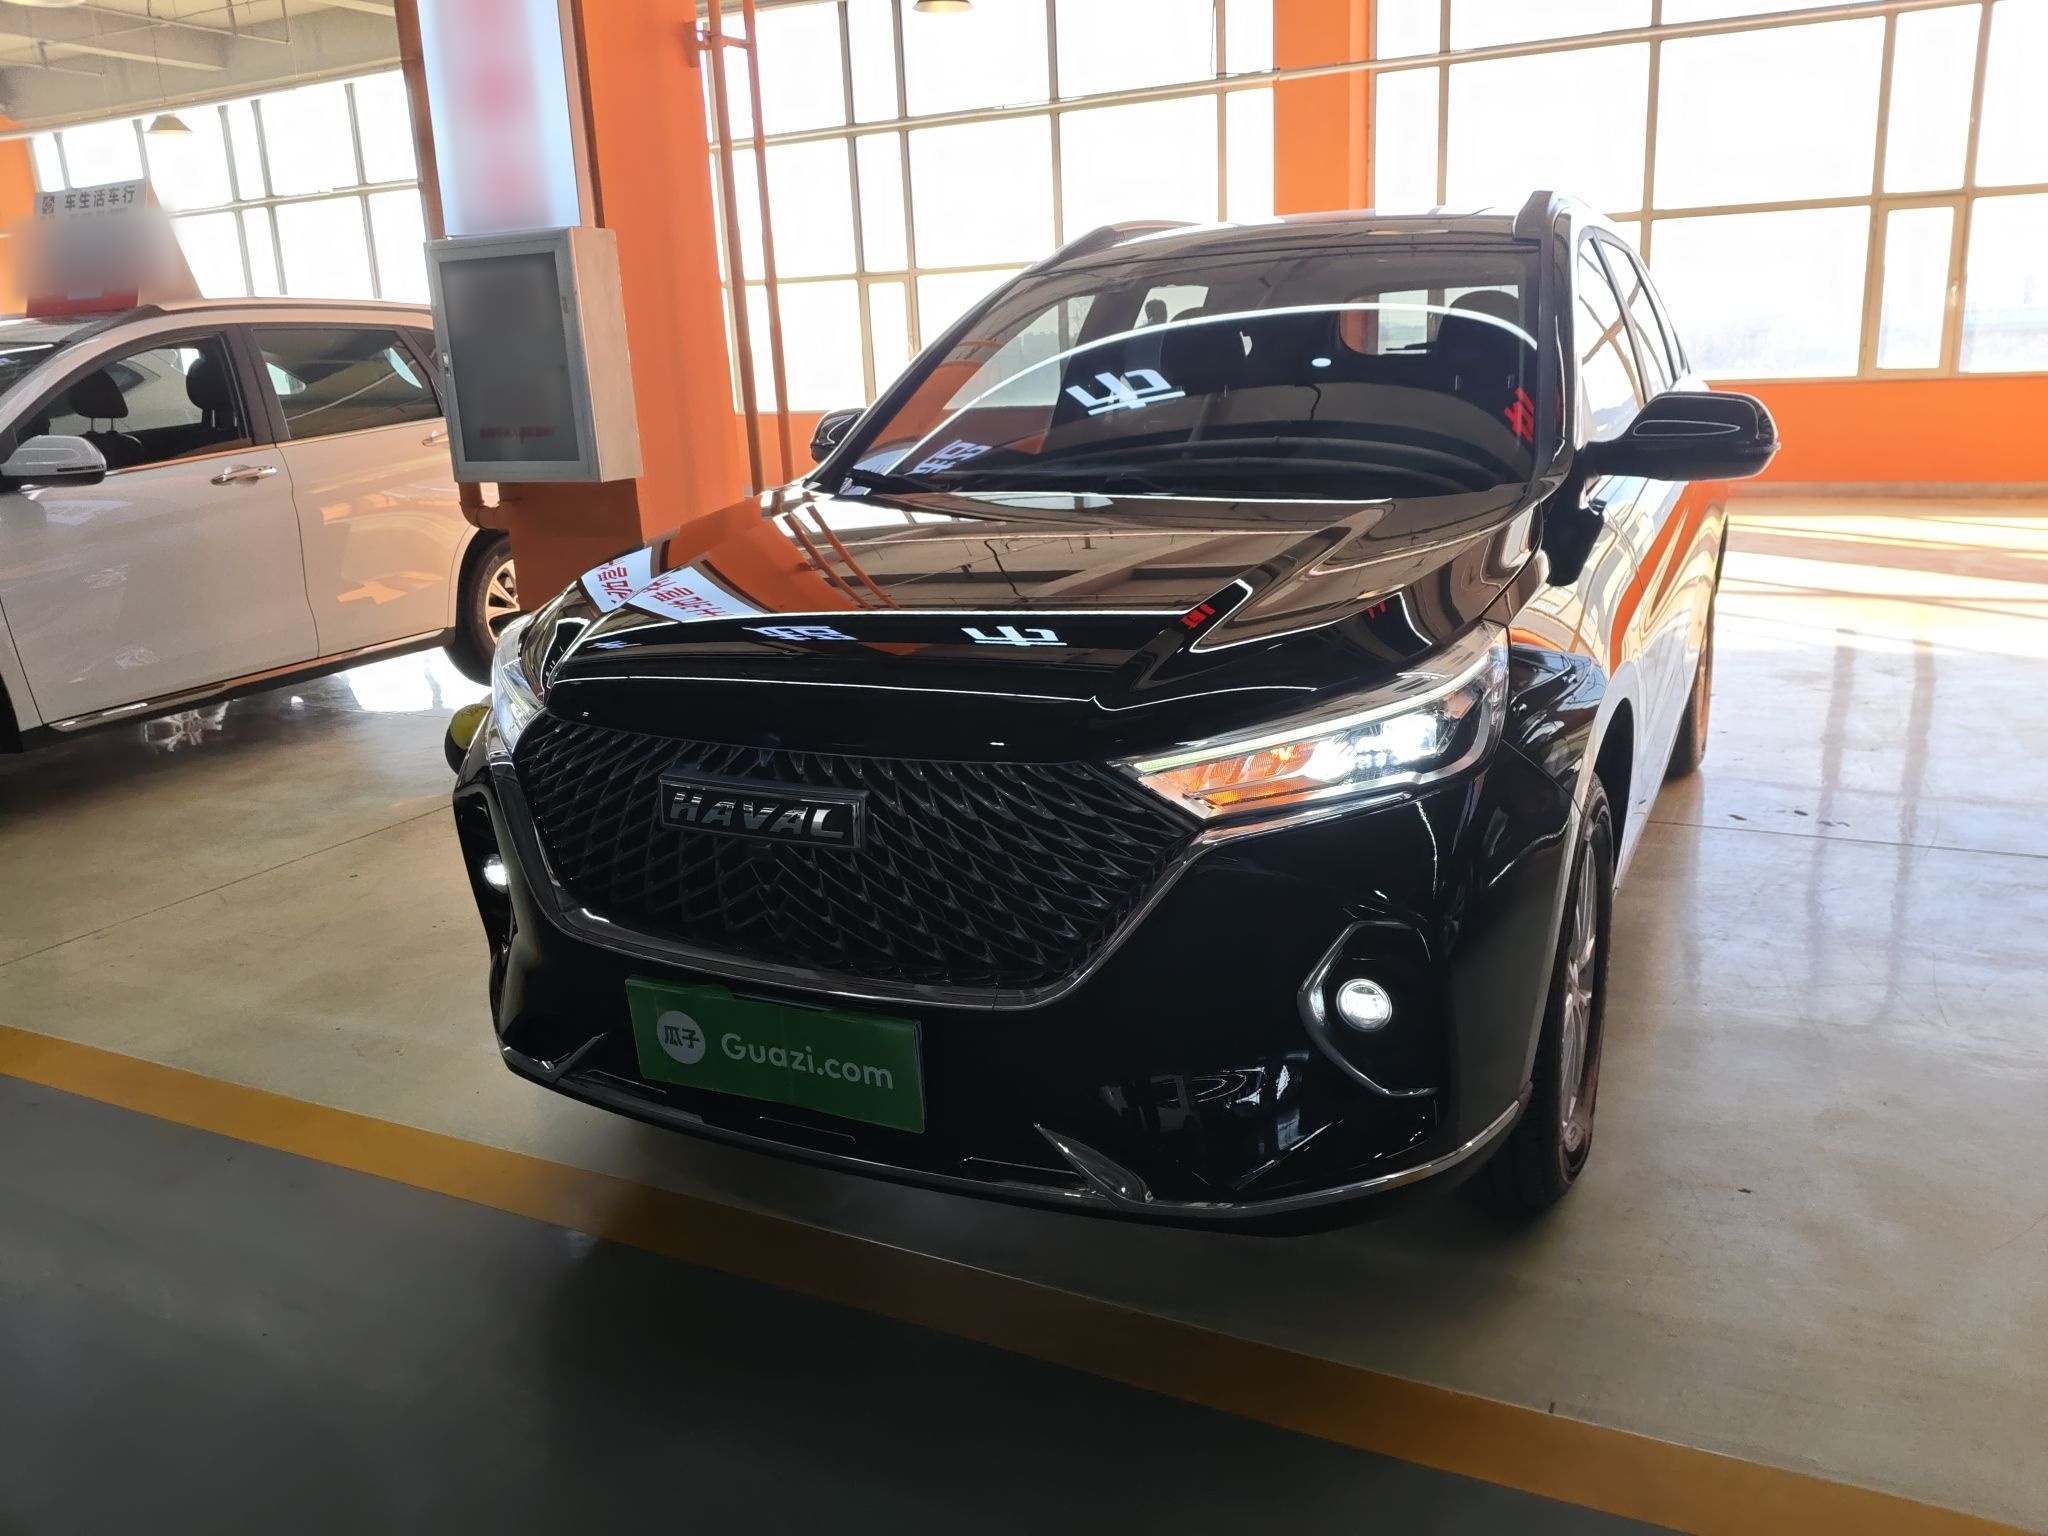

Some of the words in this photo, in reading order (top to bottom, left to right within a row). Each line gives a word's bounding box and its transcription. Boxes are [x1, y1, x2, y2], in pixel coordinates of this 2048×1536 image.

[64, 185, 136, 211] 车生活车行
[670, 792, 844, 839] HAVAL
[664, 1025, 700, 1049] 瓜子
[721, 1033, 894, 1090] Guazi.com
